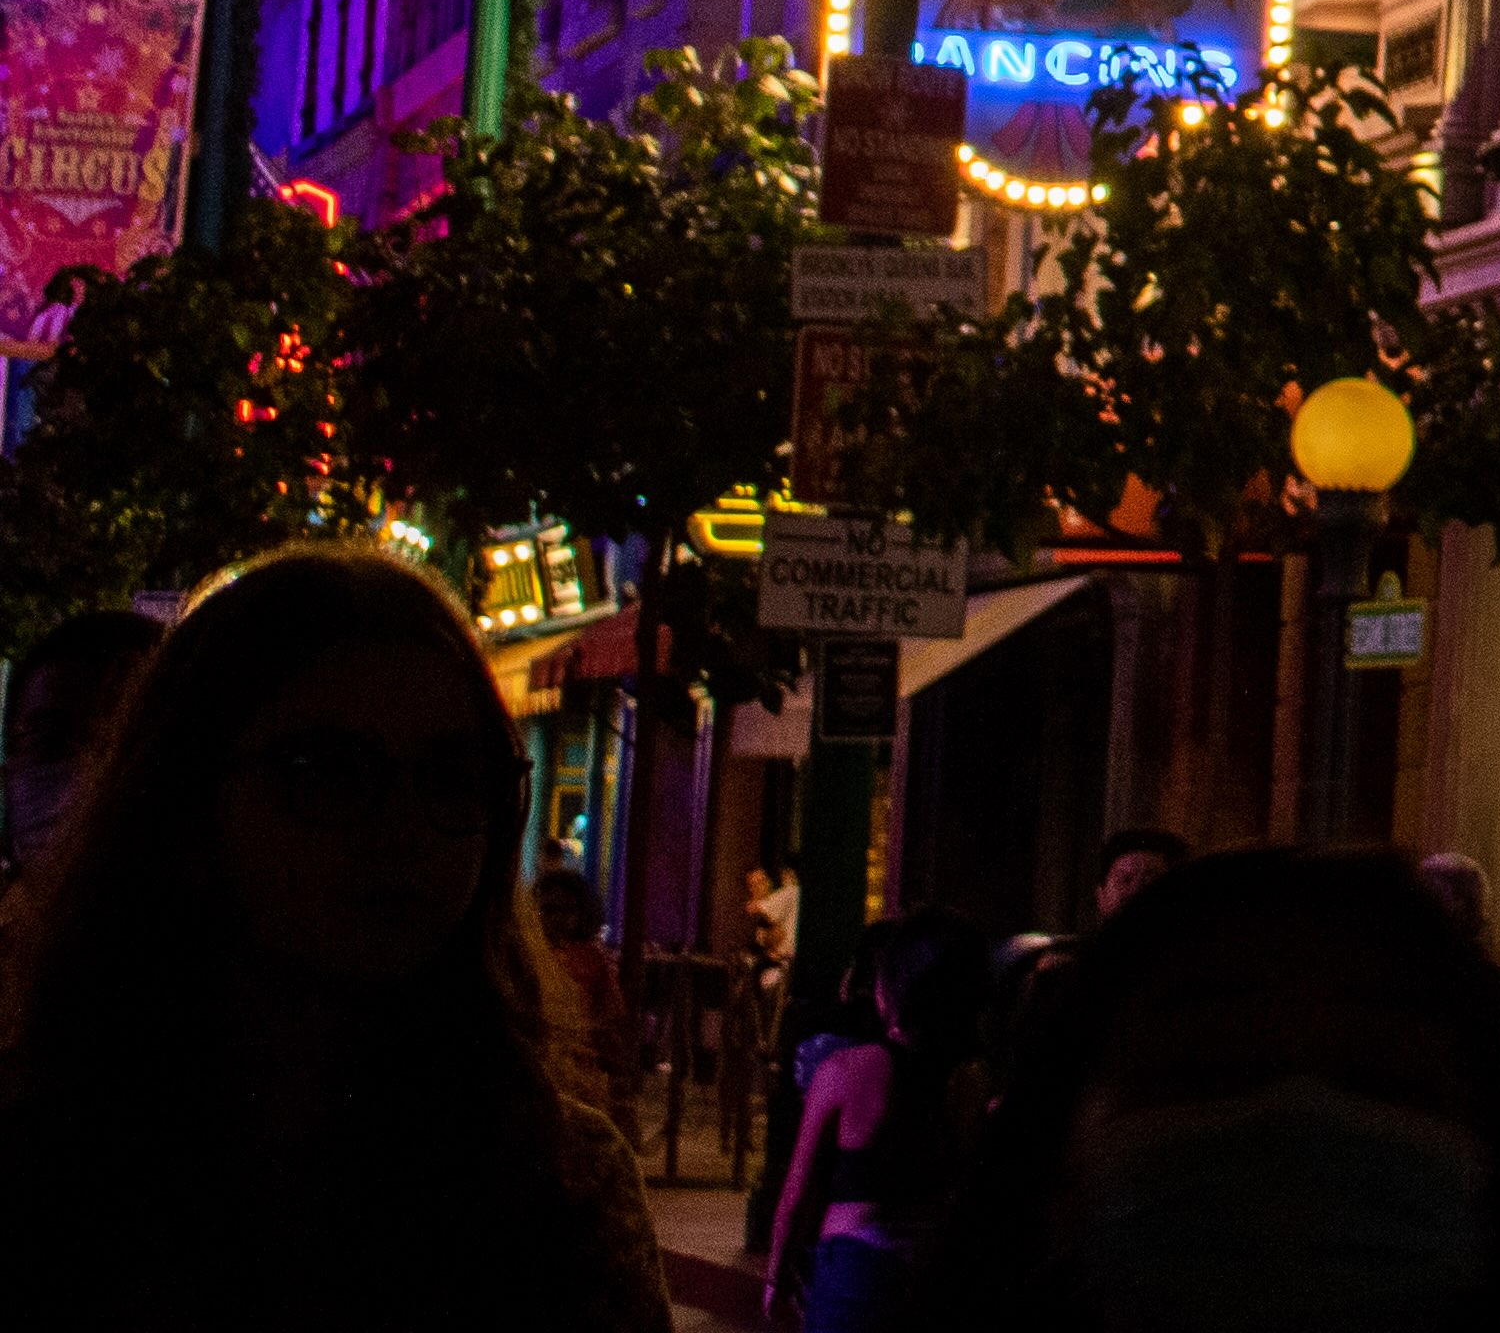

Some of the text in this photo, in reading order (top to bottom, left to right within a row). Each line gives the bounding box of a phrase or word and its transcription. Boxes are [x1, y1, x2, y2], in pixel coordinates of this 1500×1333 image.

[911, 34, 1238, 89] ANCING
[0, 135, 170, 203] CIRCUS
[849, 529, 885, 555] NO
[769, 557, 953, 594] COMMERCIAL
[806, 592, 921, 625] TRAFFIC
